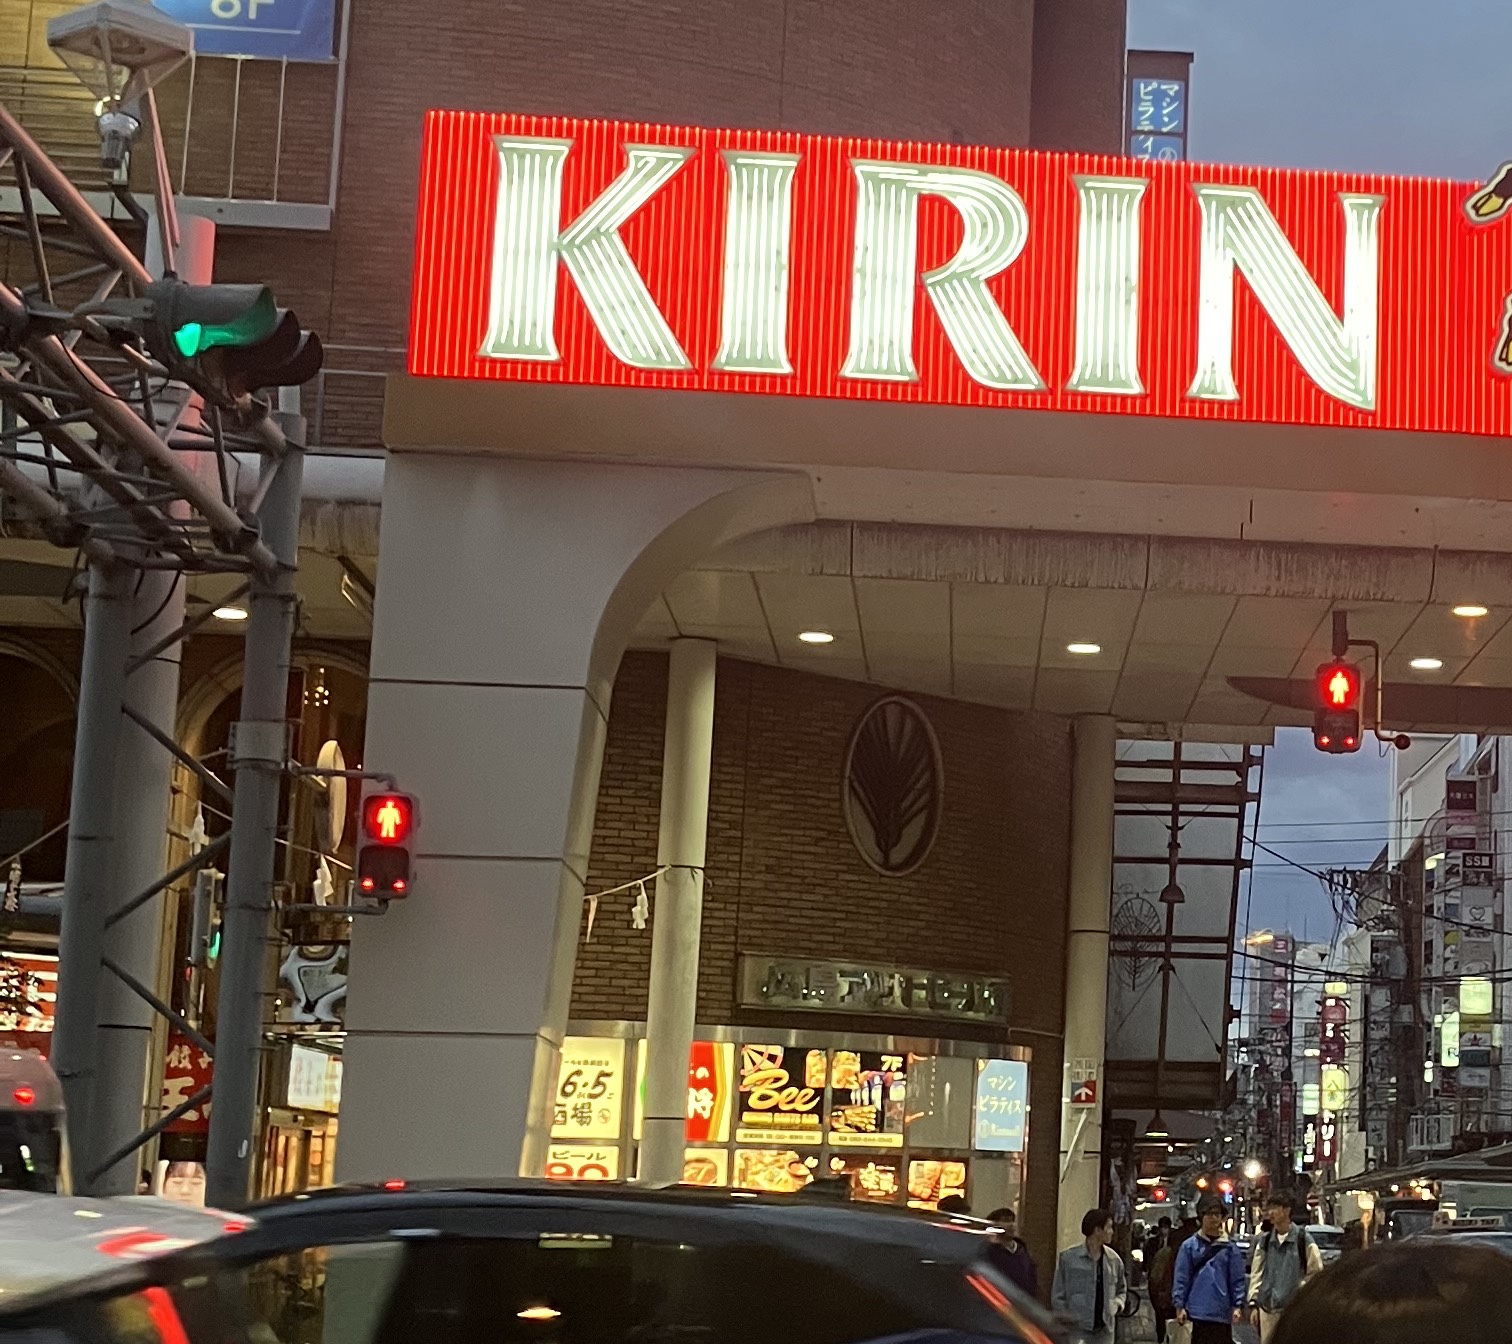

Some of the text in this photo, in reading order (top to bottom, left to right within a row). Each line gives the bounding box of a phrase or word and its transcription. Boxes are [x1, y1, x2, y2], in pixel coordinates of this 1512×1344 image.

[1159, 83, 1180, 133] マシン
[476, 133, 1384, 412] KIRIN
[742, 1068, 821, 1112] Bee
[986, 1075, 1017, 1093] マシン
[978, 1095, 1022, 1116] ピラティス
[551, 1150, 607, 1161] ビール
